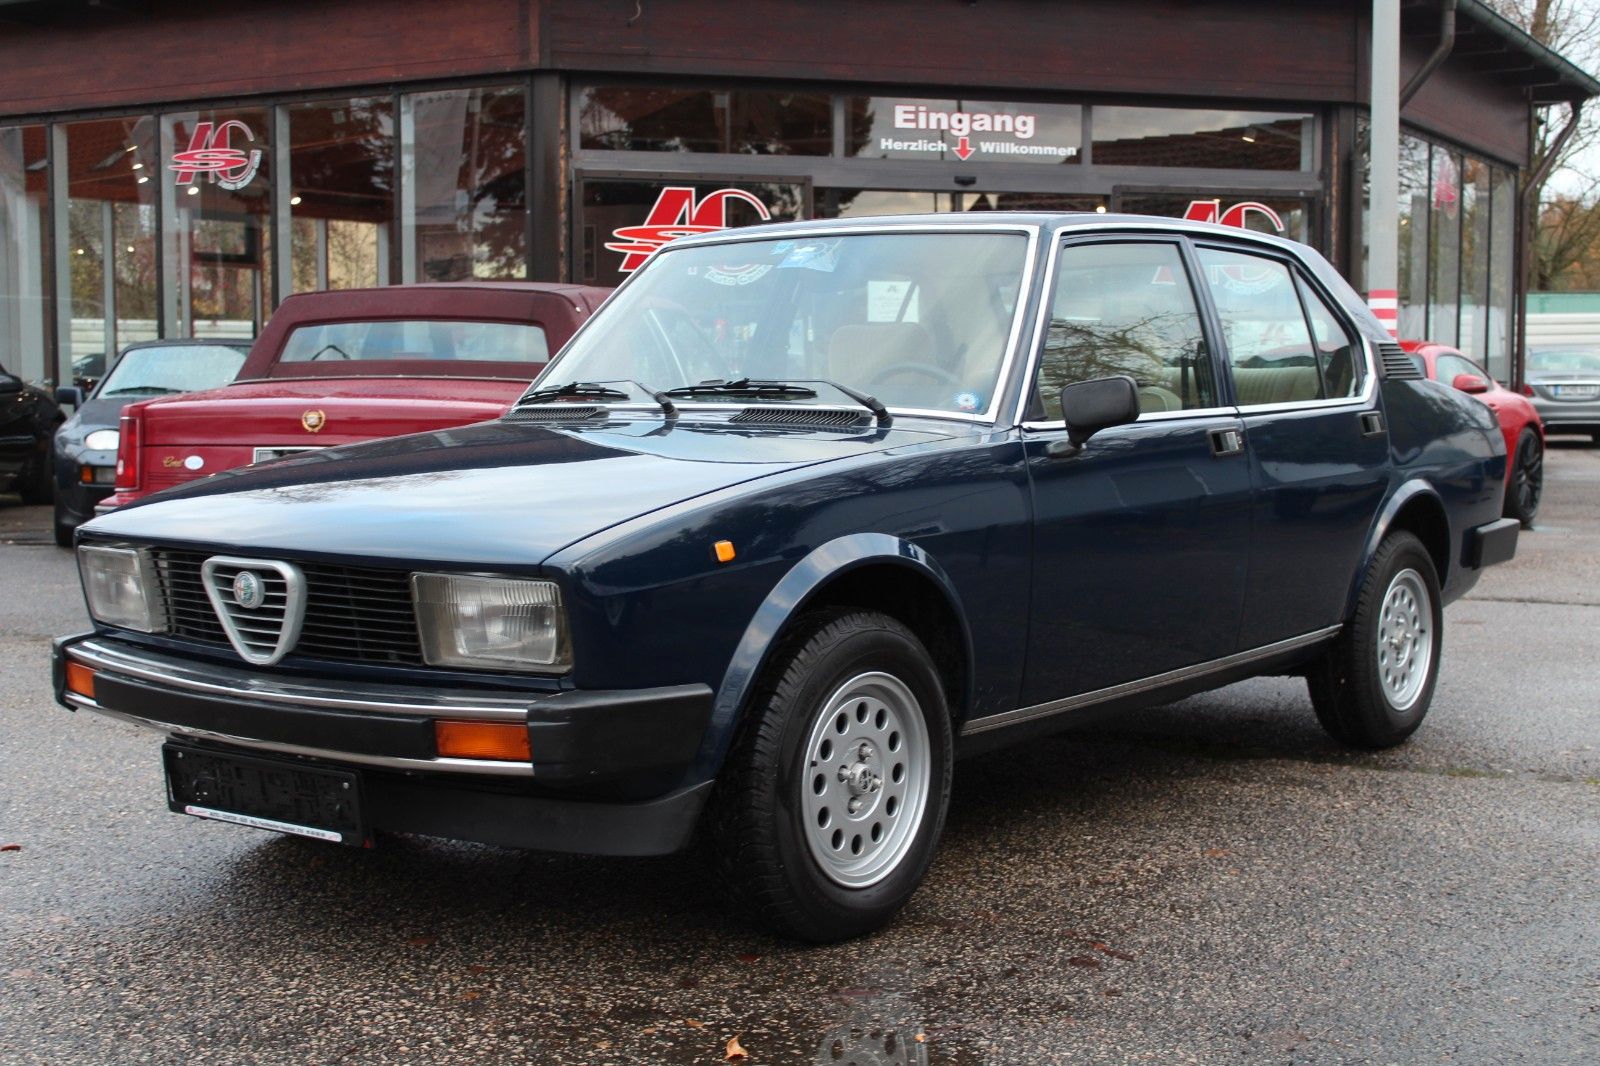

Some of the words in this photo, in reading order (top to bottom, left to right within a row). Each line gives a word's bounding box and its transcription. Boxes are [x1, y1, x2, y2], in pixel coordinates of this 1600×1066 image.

[894, 104, 1036, 139] Eingang
[880, 138, 948, 152] Herzlich
[979, 141, 1077, 156] Willkommen
